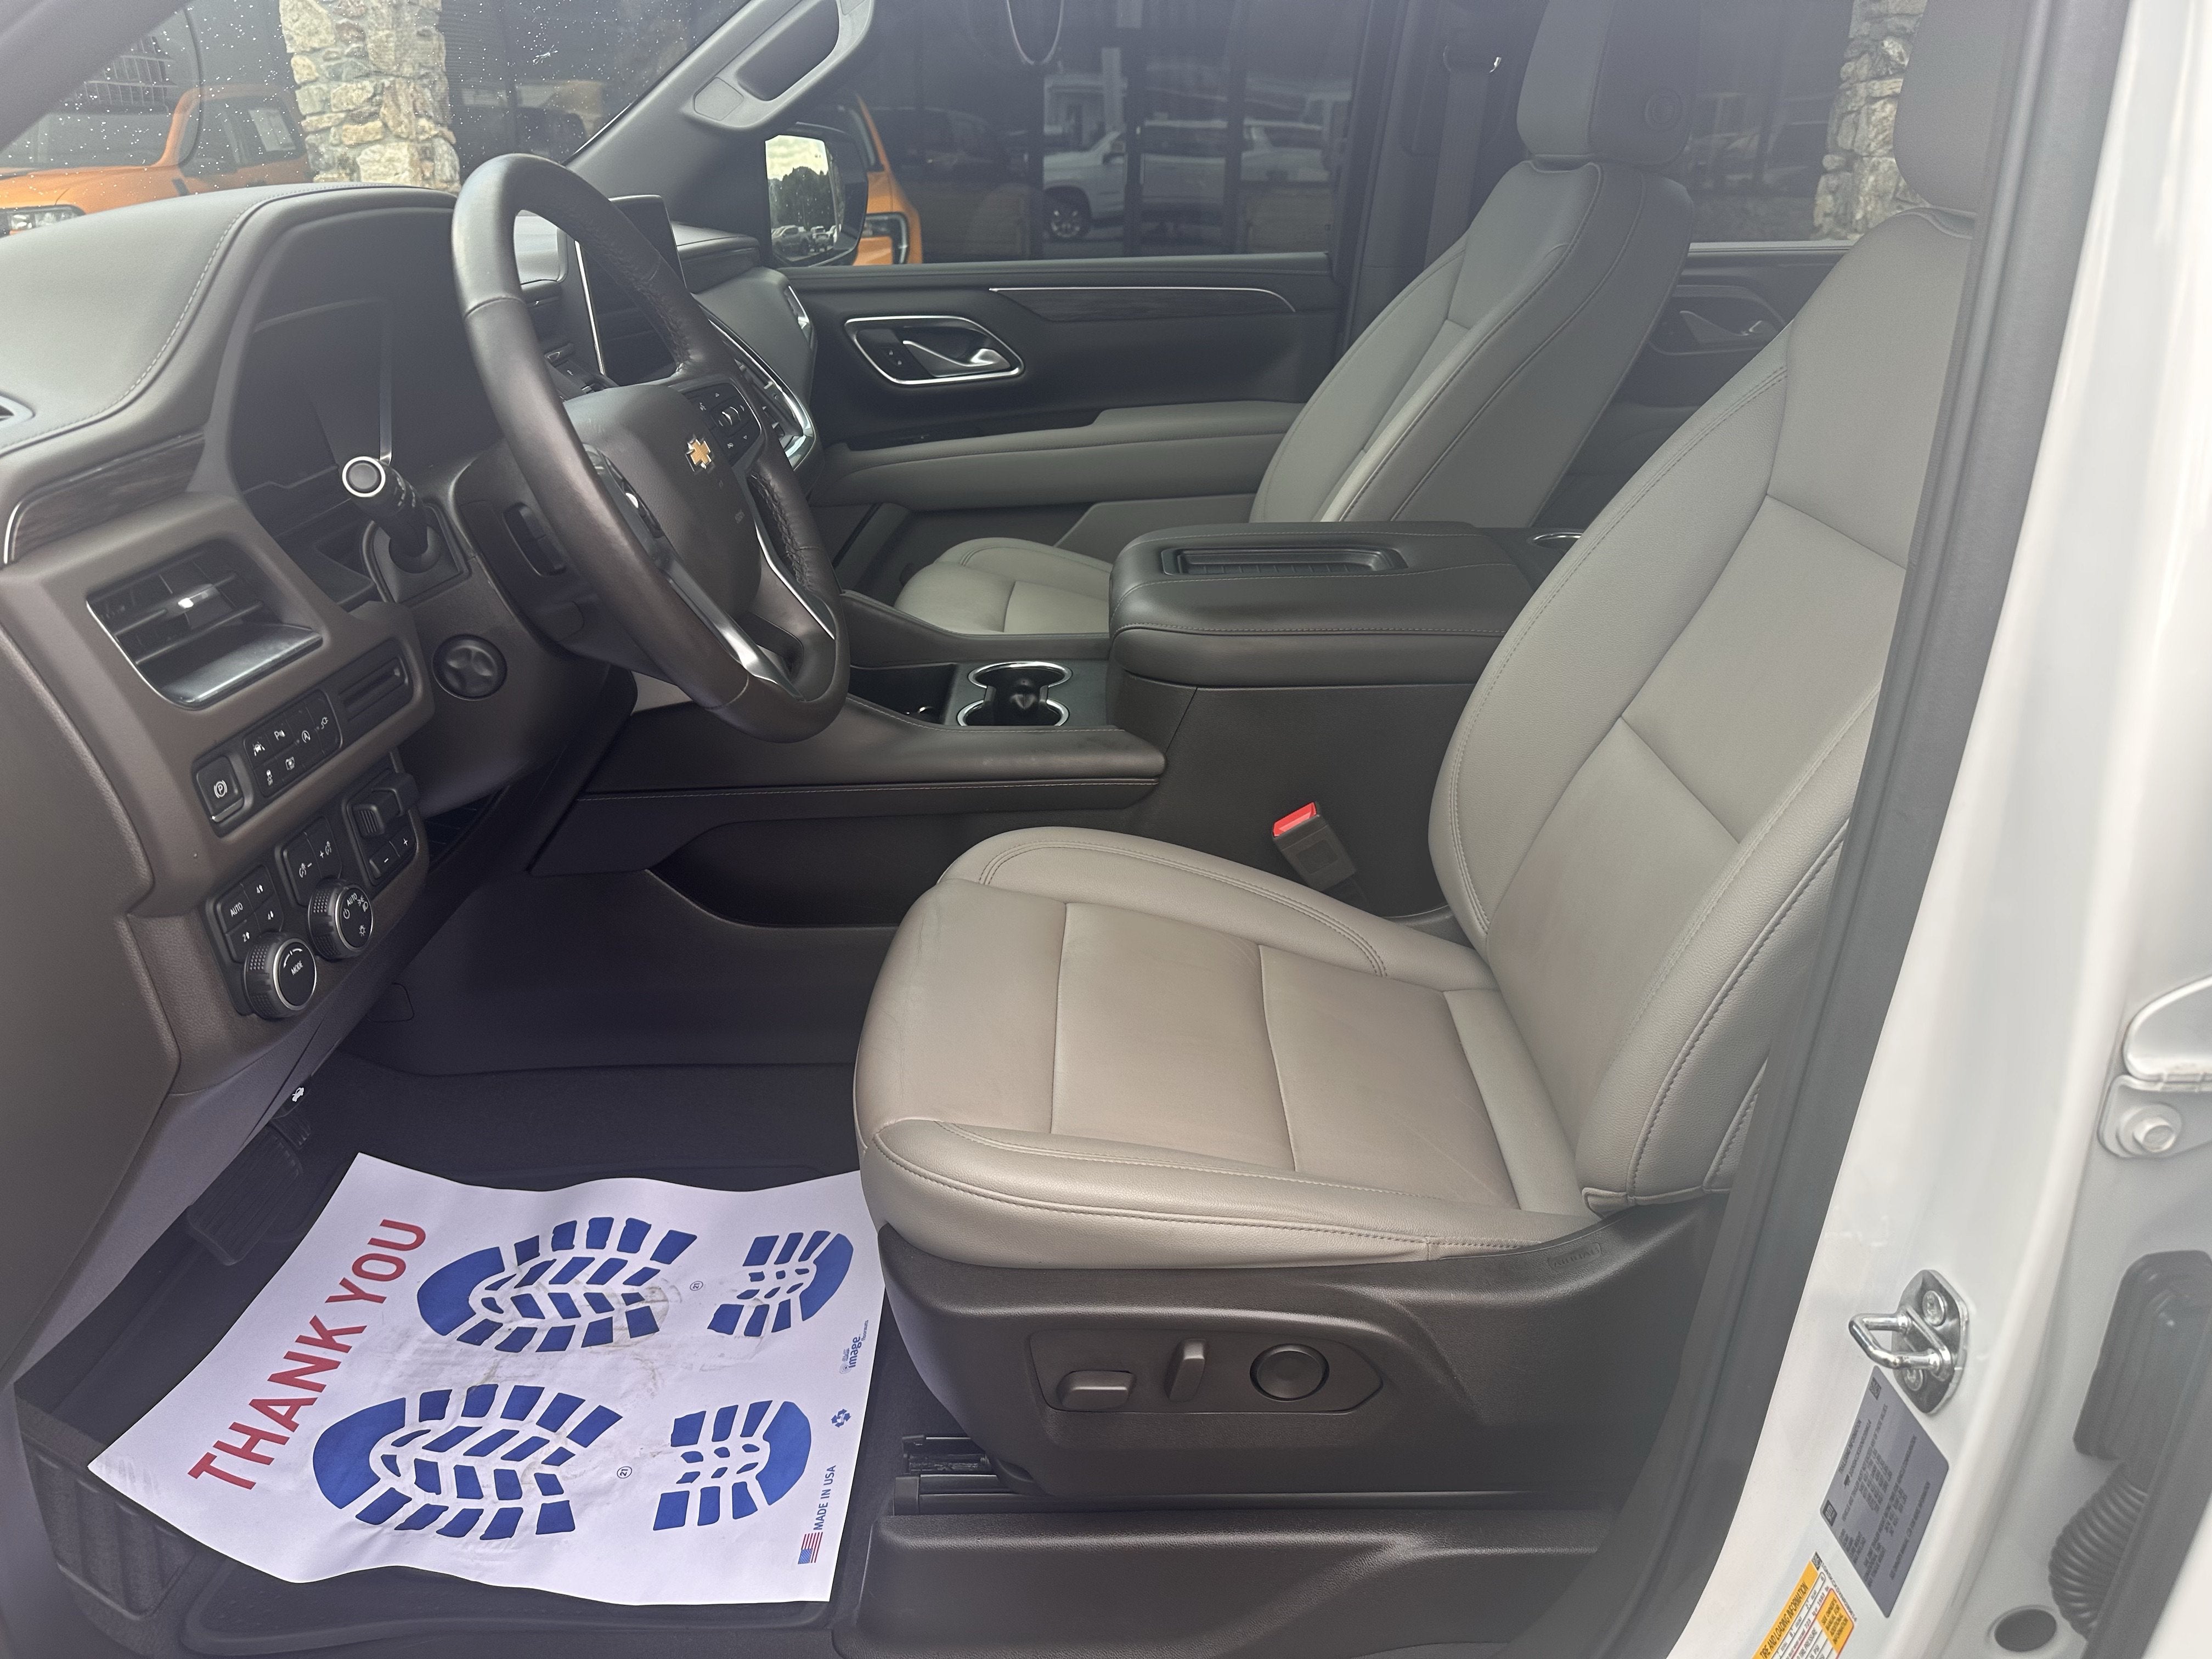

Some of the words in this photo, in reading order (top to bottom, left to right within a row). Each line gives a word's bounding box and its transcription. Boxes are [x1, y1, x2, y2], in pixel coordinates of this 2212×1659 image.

[346, 892, 358, 907] AUTO
[230, 902, 243, 917] AUTO
[290, 960, 303, 975] MODE
[188, 1314, 367, 1490] THANK
[325, 1218, 426, 1305] YOU
[848, 1336, 862, 1368] image
[823, 1465, 836, 1486] USA
[820, 1488, 831, 1499] IN
[813, 1502, 828, 1530] MADE
[1817, 1592, 1825, 1606] 1593
[1760, 1645, 1770, 1659] TIRE
[1767, 1634, 1777, 1651] AND
[1773, 1613, 1790, 1640] LOADING
[1786, 1581, 1808, 1619] INFORMATION
